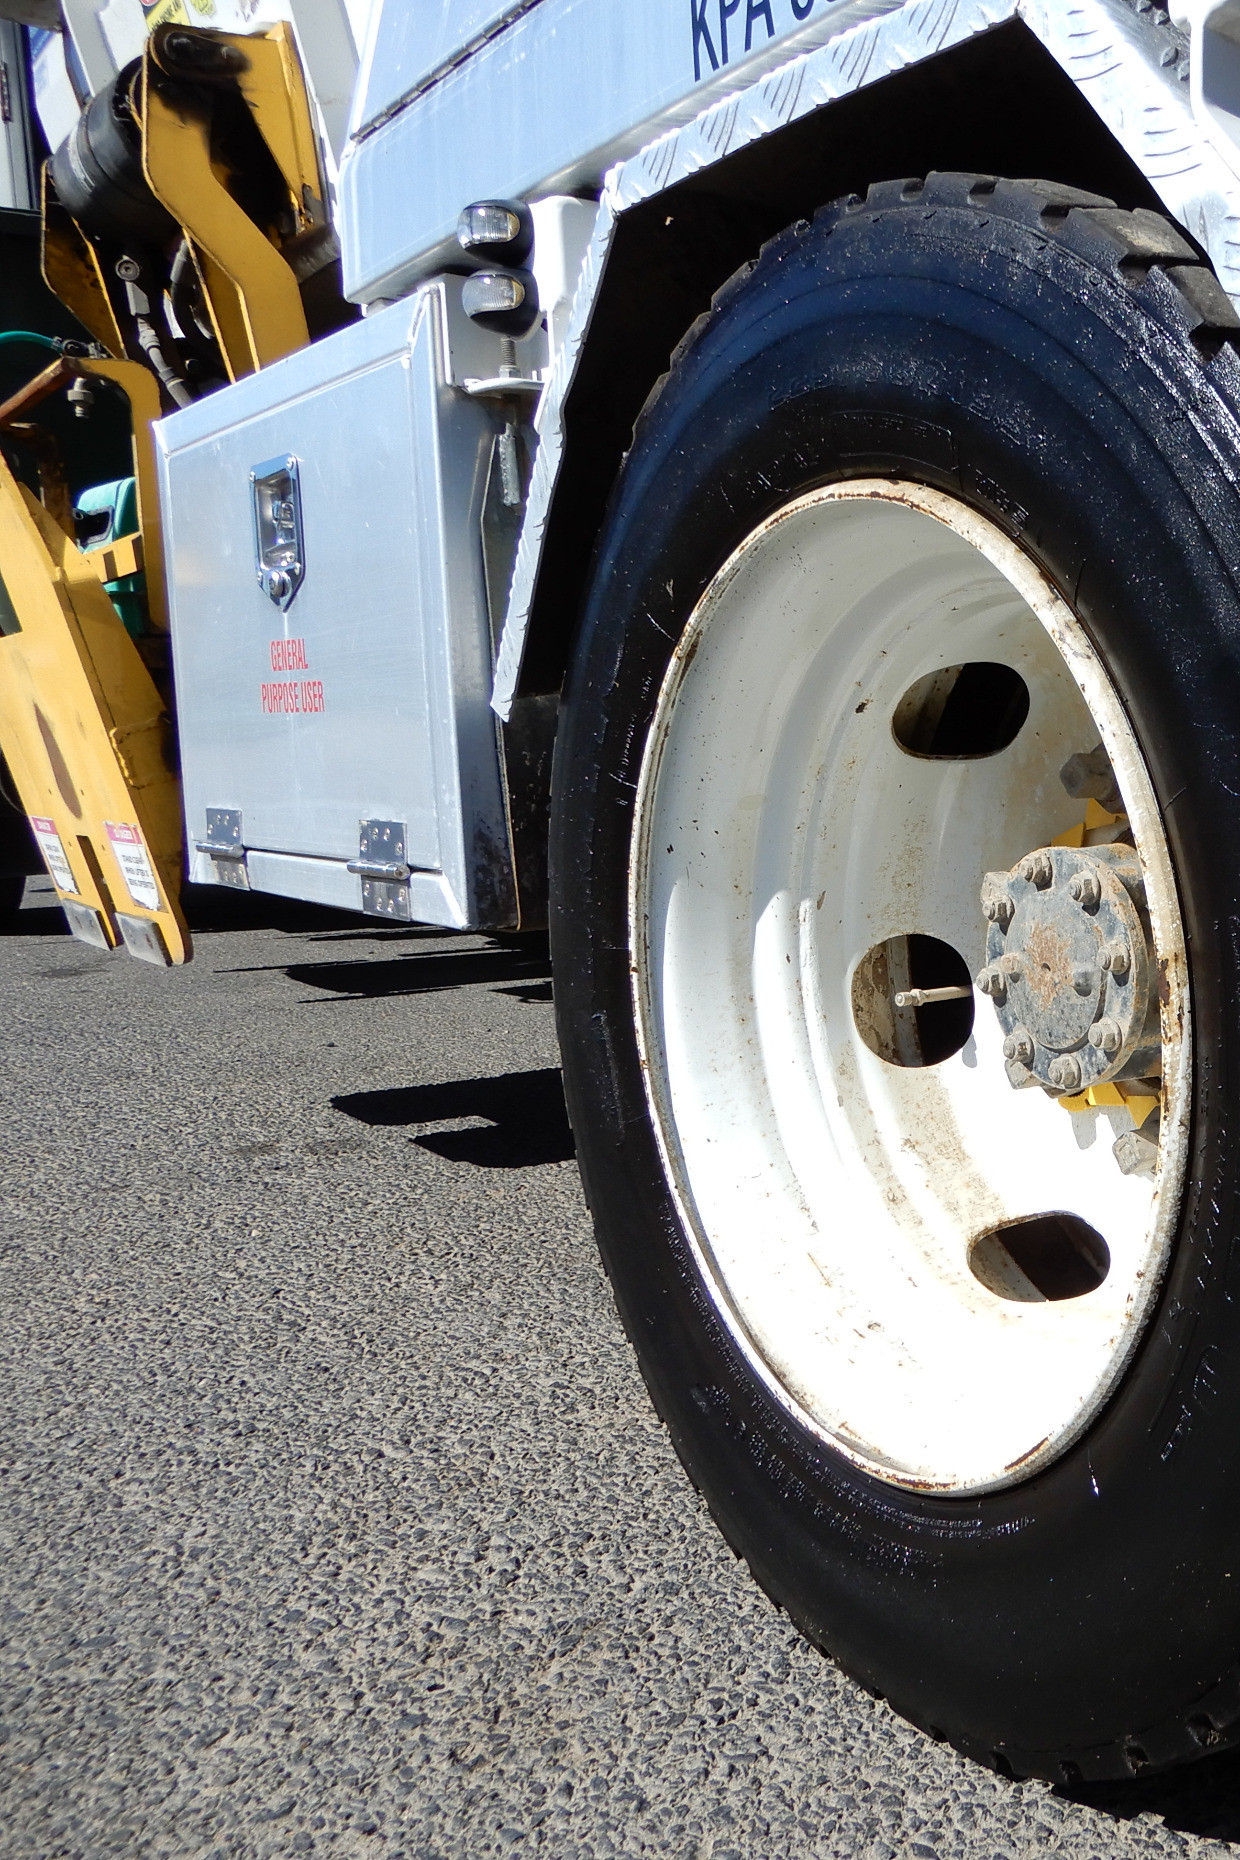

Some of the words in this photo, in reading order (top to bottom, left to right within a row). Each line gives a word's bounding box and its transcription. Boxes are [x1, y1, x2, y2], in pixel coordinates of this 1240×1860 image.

[270, 638, 309, 672] GENERAL
[261, 682, 300, 714] PURPOSE
[300, 681, 325, 713] USER
